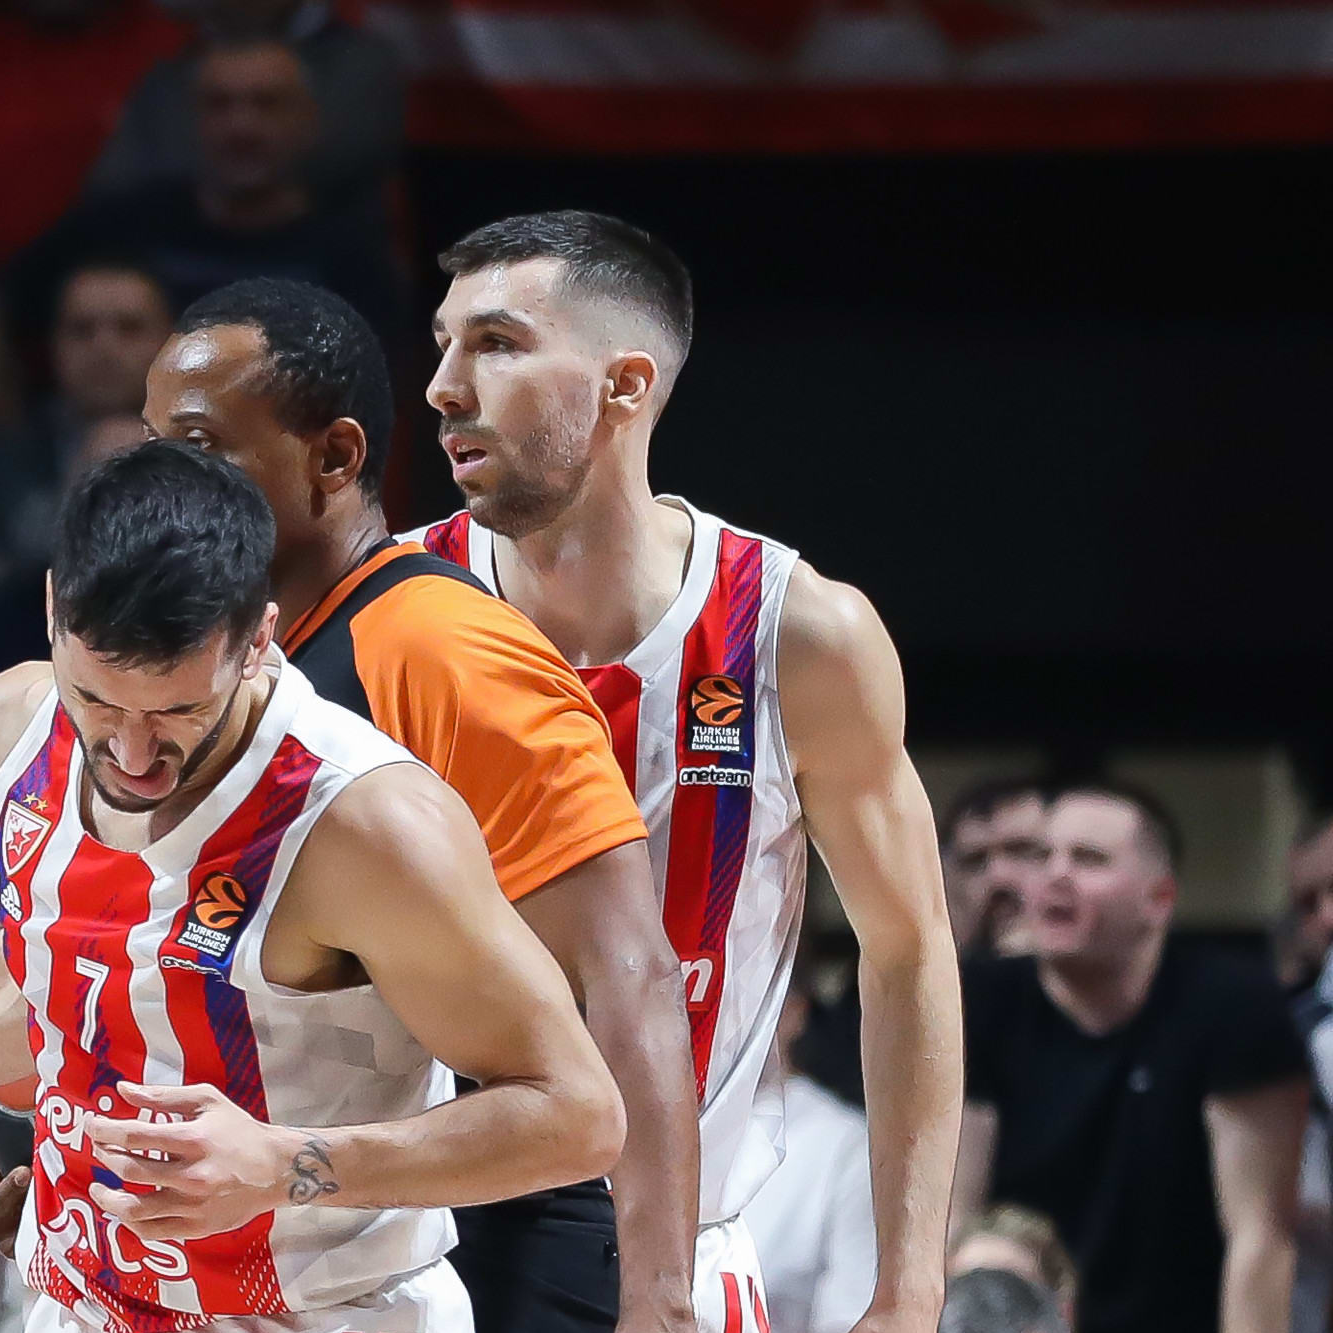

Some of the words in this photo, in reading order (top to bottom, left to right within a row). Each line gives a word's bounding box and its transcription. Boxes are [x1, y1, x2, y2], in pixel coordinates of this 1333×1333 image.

[691, 735, 741, 746] AIRLINES
[692, 726, 741, 738] TURKISH
[680, 766, 752, 787] oneteam
[181, 931, 227, 953] AIRLINES
[187, 921, 232, 945] TURKISH
[74, 955, 110, 1053] 7
